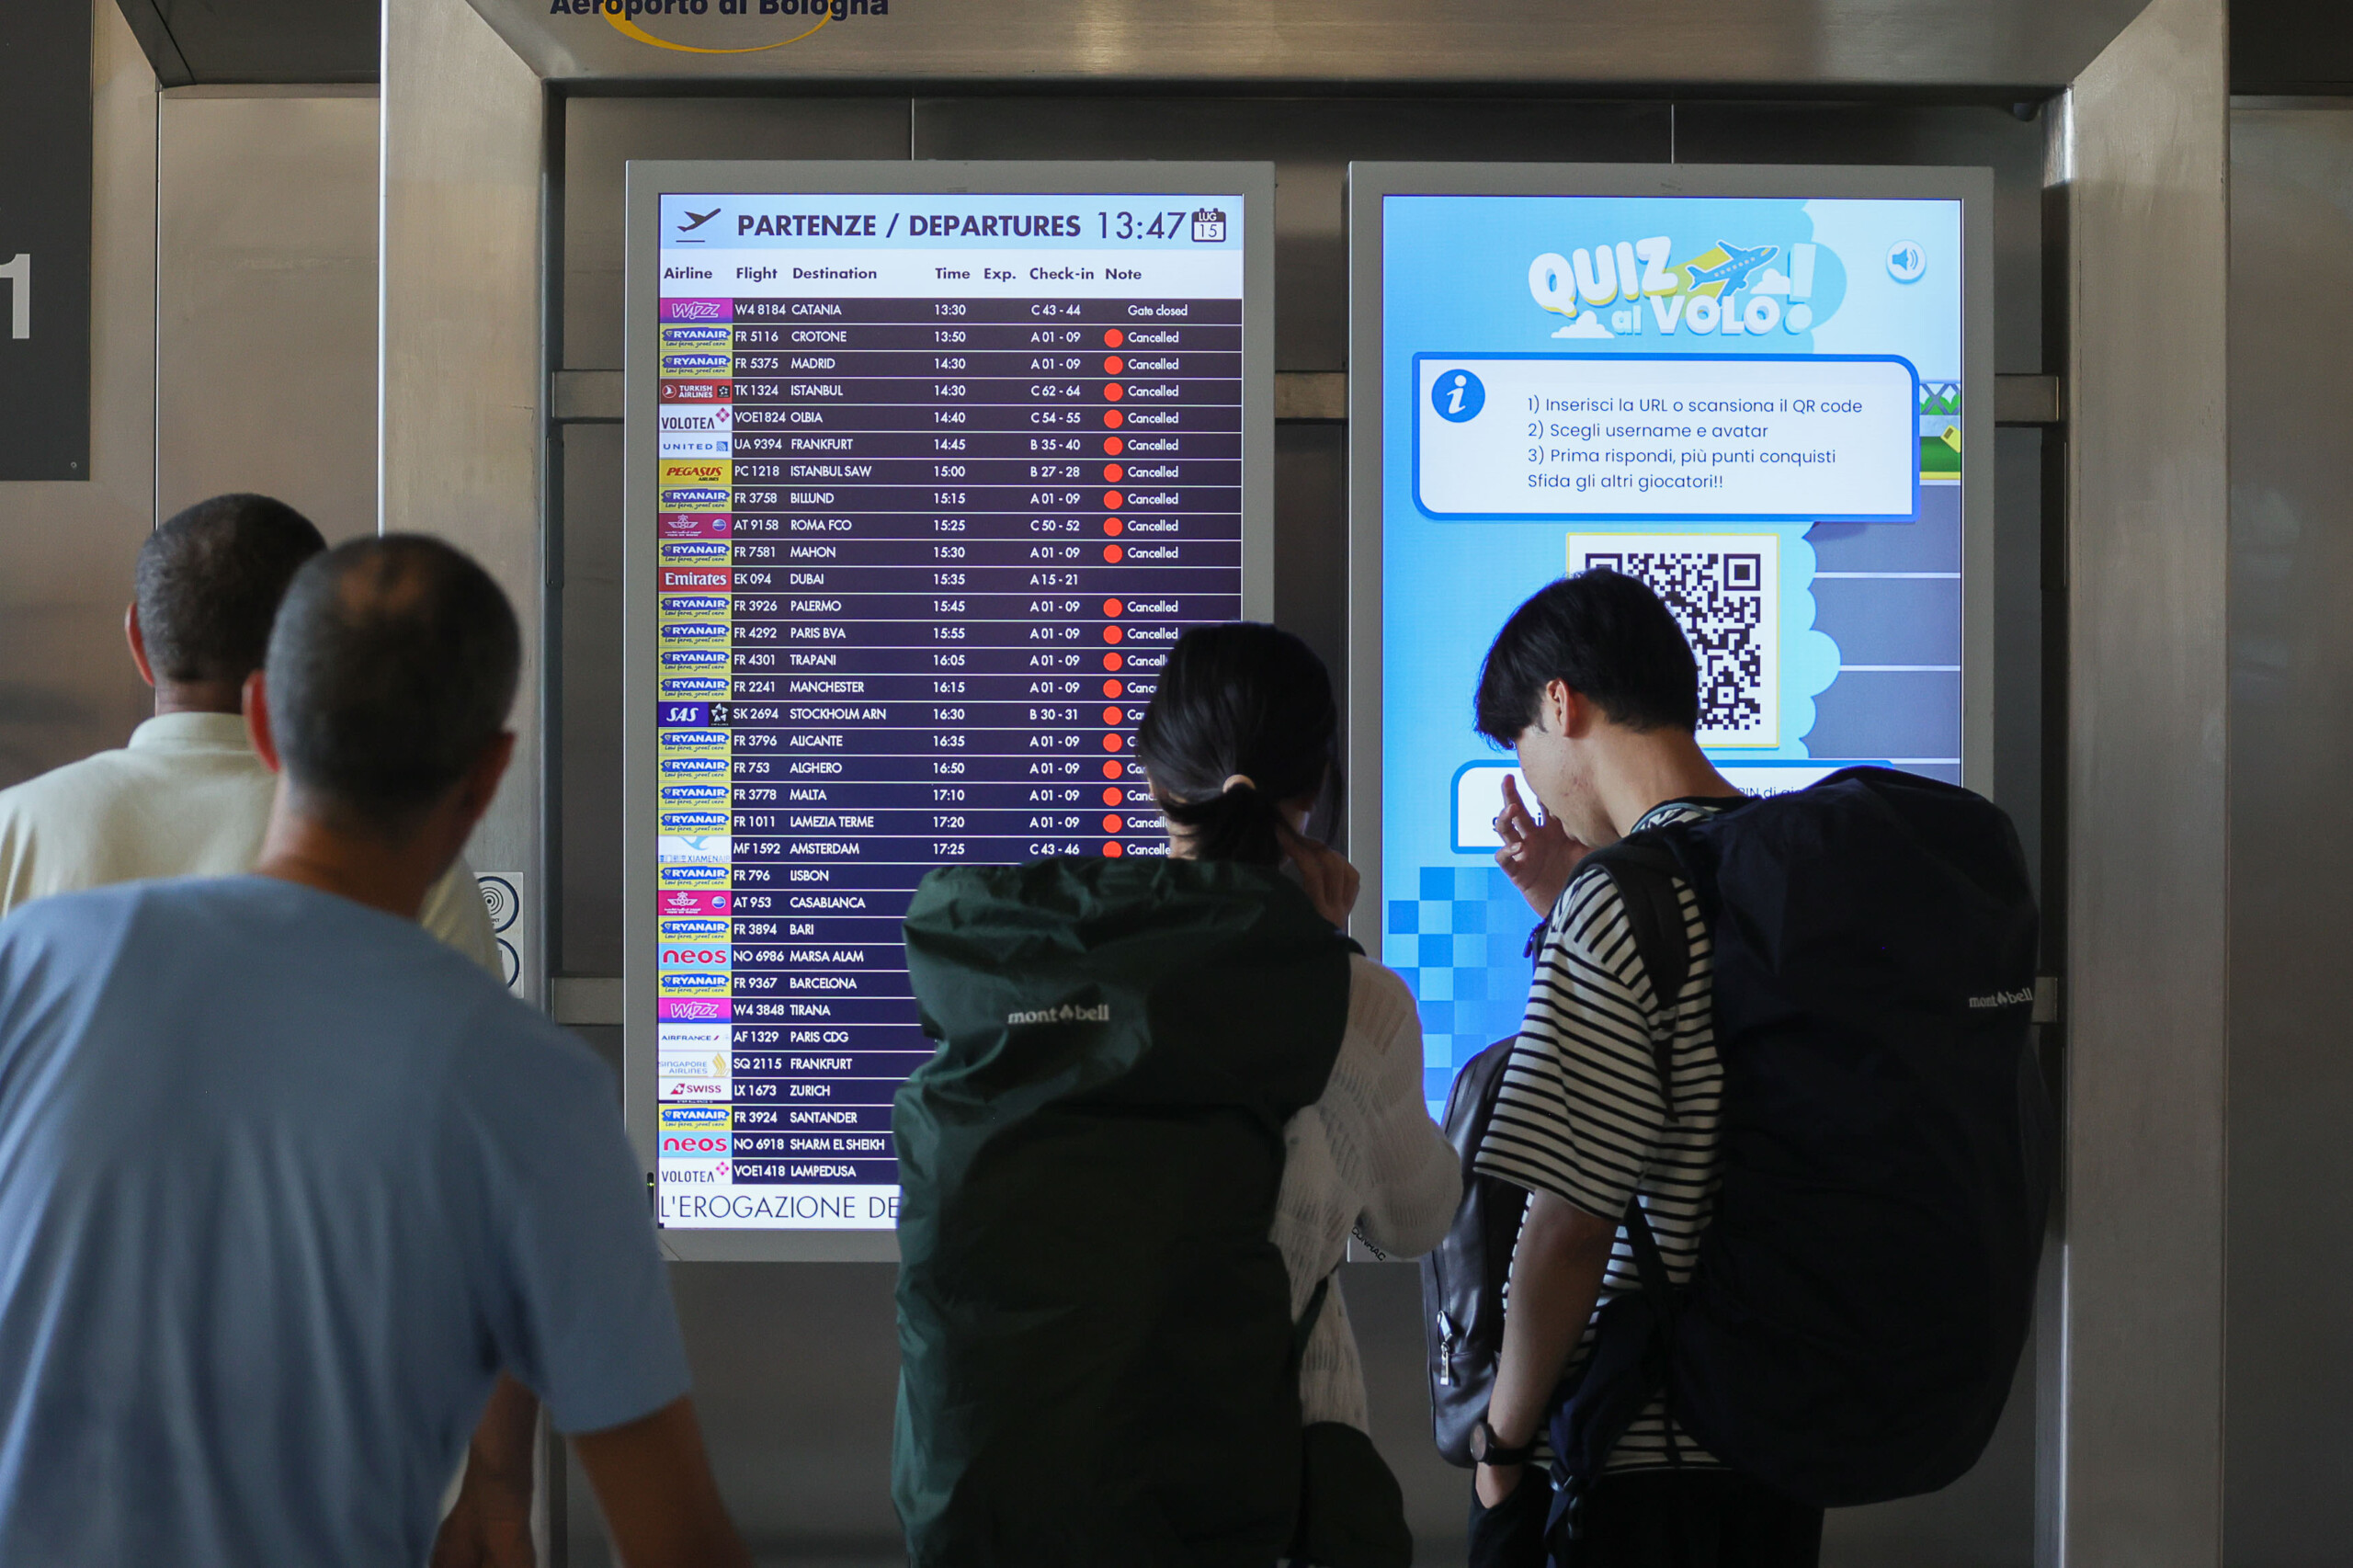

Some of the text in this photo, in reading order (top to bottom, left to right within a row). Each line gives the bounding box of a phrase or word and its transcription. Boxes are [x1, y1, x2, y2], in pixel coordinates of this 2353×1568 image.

[759, 0, 889, 21] Bologna
[1199, 212, 1217, 222] LUG
[738, 210, 1187, 240] PARTENZE / DEPARTURES 13:47
[1199, 224, 1217, 238] 15
[664, 266, 1142, 283] Airline Flight Destination Time Exp. Check-in Note
[1529, 236, 1679, 318] QUIZ
[791, 303, 1188, 316] CATANIA 13:30 Gate closed
[734, 330, 747, 342] FR
[749, 330, 779, 342] 5116
[790, 330, 847, 343] CROTONE
[935, 331, 966, 343] 13:50
[1128, 330, 1179, 344] Cancelled
[790, 358, 1179, 370] MADRID 14:30 Cancelled
[733, 384, 1179, 397] TK 1324 ISTANBUL 14:30 Cancelled
[1528, 394, 1863, 415] 1) Inserisci la URL o scansiona il QR code
[790, 411, 824, 423] OLBIA
[934, 411, 966, 424] 14:40
[1127, 411, 1179, 424] Cancelled
[1528, 419, 1768, 442] 2) Scegli username e avatar
[790, 437, 854, 450] FRANKFURT
[934, 437, 966, 450] 14:45
[1127, 437, 1179, 451] Cancelled
[1528, 445, 1836, 468] 3) Prima rispondi, più punti conquisti
[666, 465, 1179, 478] PEGASUS ISTANBUL SAW 15:00 Cancelled
[1528, 473, 1722, 493] Sfida gli altri giocatori!!
[790, 492, 1179, 505] BILLUND 15:15 Cancelled
[790, 518, 1179, 532] ROMA FCO 15:25 Cancelled
[790, 546, 1179, 559] MAHON 15:30 Cancelled
[665, 573, 966, 585] Emirates DUBAI 15:35
[673, 599, 1178, 613] RYANAIR PALERMO 15:45 Cancelled
[790, 627, 1178, 640] PARIS BVA 15:55 Cancelled
[789, 653, 965, 666] TRAPANI 16:05
[790, 680, 965, 693] MANCHESTER 16:15
[666, 708, 965, 722] SAS STOCKHOLM ARN 16:30
[789, 734, 965, 747] ALICANTE 16:35
[789, 762, 965, 774] ALGHERO 16:50
[789, 789, 965, 801] MALTA 17:10
[790, 815, 965, 828] LAMEZIA TERME 17:20
[789, 842, 965, 855] AMSTERDAM 17:25
[790, 869, 829, 882] LISBON
[790, 896, 867, 909] CASABLANCA
[790, 923, 814, 936] BARI
[663, 949, 864, 964] neos MARSA ALAM
[790, 977, 858, 990] BARCELONA
[1969, 987, 2033, 1007] mont bell
[789, 1004, 831, 1017] TIRANA
[1007, 1004, 1109, 1024] mont bell
[790, 1030, 821, 1043] PARIS
[823, 1030, 849, 1043] CDG
[790, 1057, 853, 1070] FRANKFURT
[790, 1085, 831, 1096] ZURICH
[673, 1110, 858, 1124] RYANAIR SANTANDER
[664, 1138, 885, 1151] neos SHARM EL SHEIKH
[790, 1165, 857, 1177] LAMPEDUSA
[661, 1196, 856, 1219] L'EROGAZIONE
